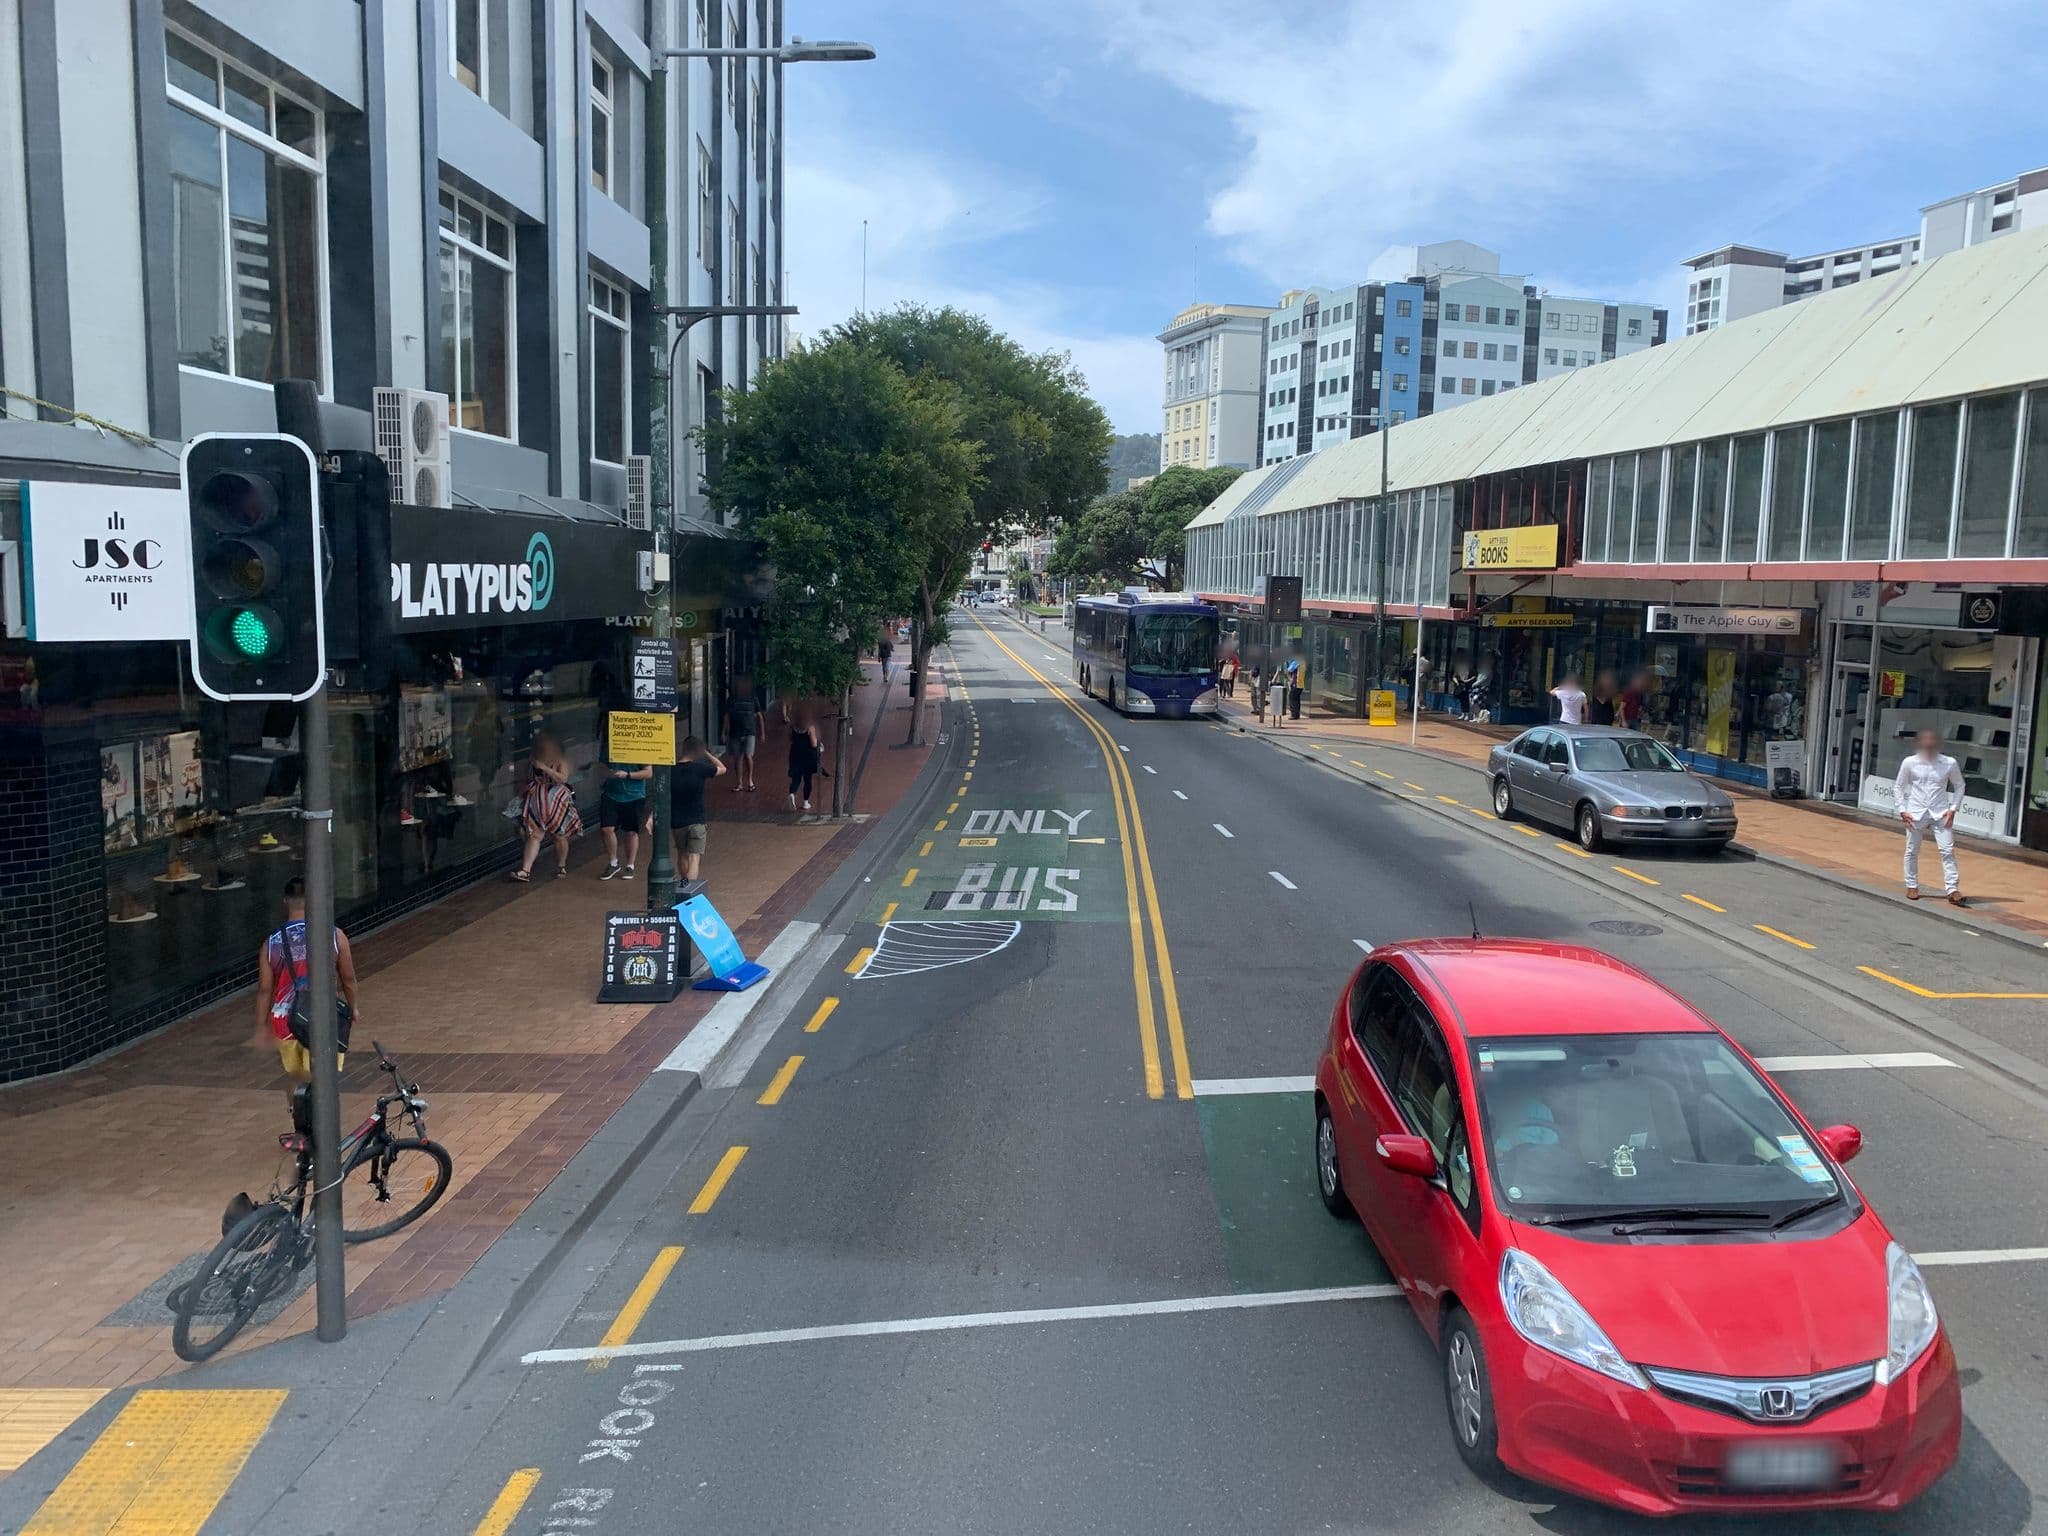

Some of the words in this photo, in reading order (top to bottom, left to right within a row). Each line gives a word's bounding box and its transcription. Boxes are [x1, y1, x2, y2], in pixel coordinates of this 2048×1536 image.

[72, 538, 163, 569] JSC
[1481, 546, 1508, 564] BOOKS
[85, 575, 153, 583] APARTMENTS
[605, 615, 684, 628] PLATYS
[1682, 614, 1705, 625] The
[1708, 615, 1744, 627] Apple
[1747, 615, 1771, 628] Guy
[659, 640, 669, 648] city
[613, 723, 638, 732] footpath
[1873, 783, 1895, 799] Apple
[1962, 803, 1995, 821] Service
[961, 810, 1093, 835] ONLY
[943, 863, 1081, 912] BUS
[606, 927, 616, 985] TATTOO
[667, 926, 676, 985] BARBER
[579, 1364, 685, 1464] LOOK
[542, 1488, 615, 1536] RI
